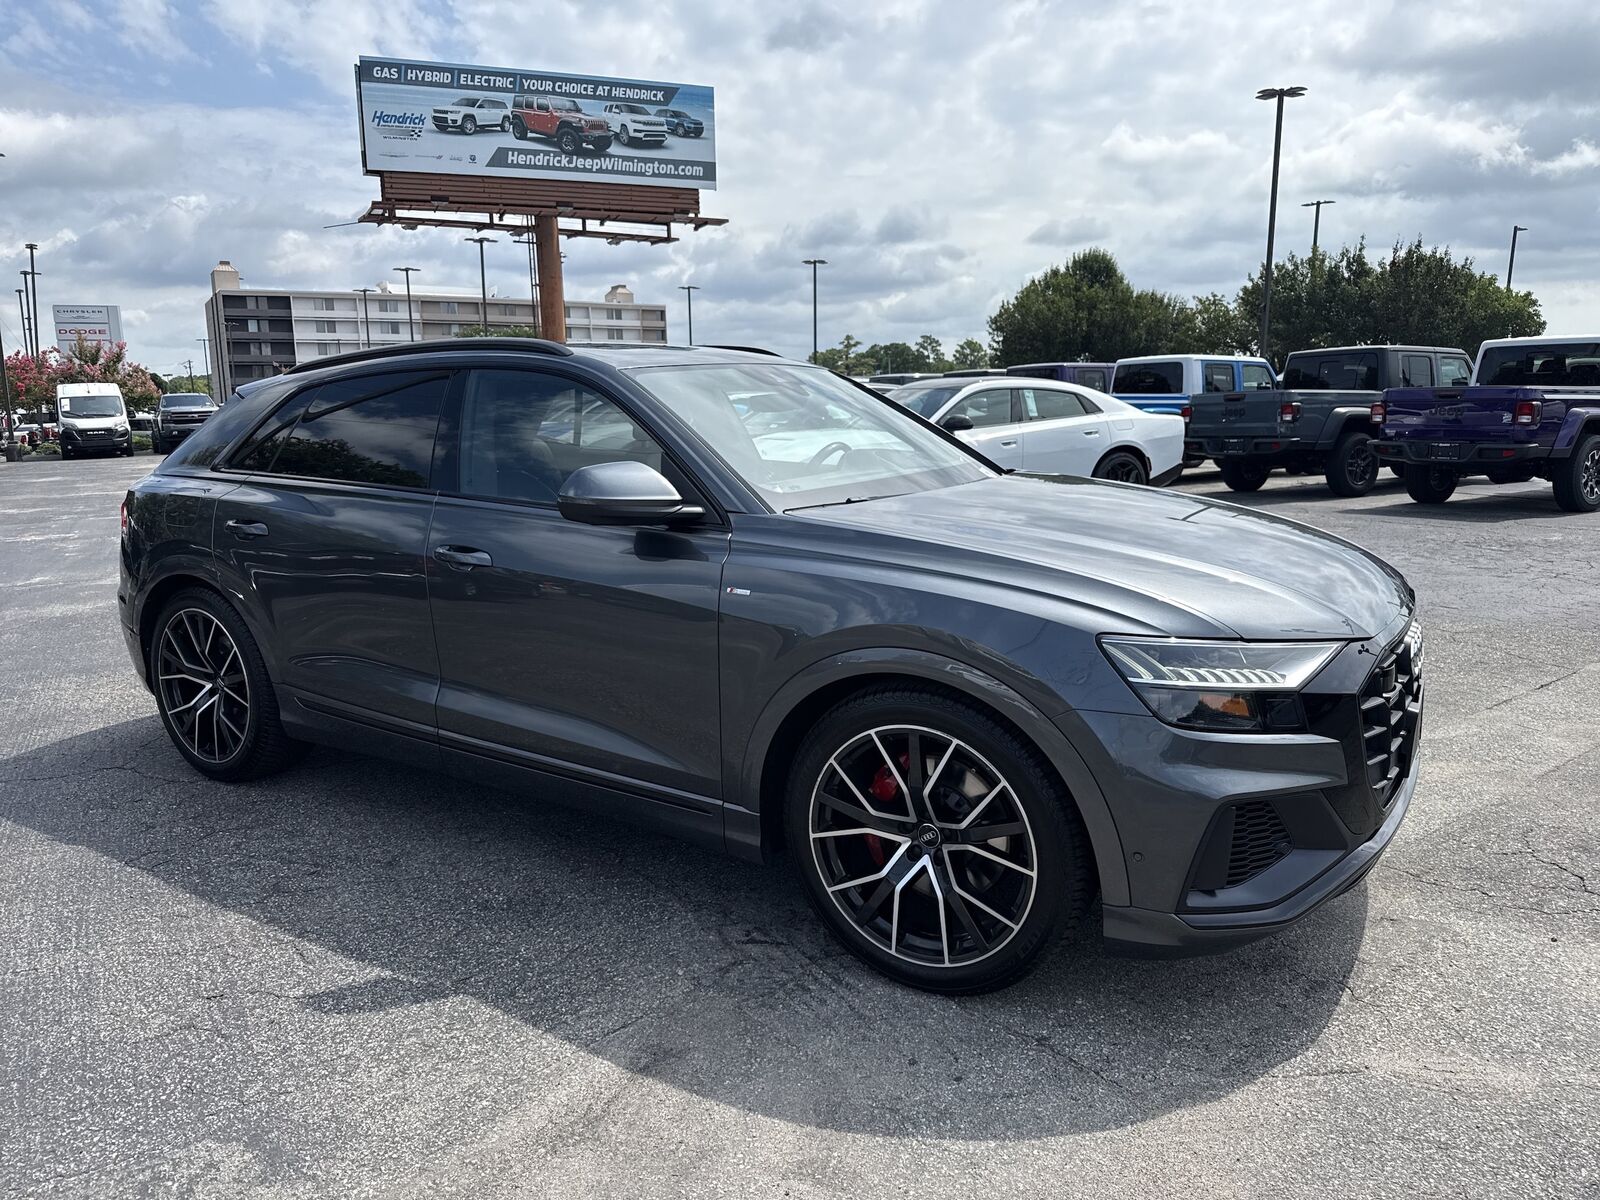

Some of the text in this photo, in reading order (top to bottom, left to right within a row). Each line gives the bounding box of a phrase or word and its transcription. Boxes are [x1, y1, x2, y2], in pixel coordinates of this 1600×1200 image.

[373, 66, 399, 79] GAS
[407, 69, 452, 83] HYBRID
[460, 73, 514, 88] ELECTRIC
[522, 78, 665, 102] YOUR CHOICE AT HENDRICK
[371, 110, 426, 127] Hendrick
[507, 151, 704, 177] HendrickJeepWilmington.com
[1221, 406, 1246, 418] Jeep
[1429, 404, 1464, 418] Jeep
